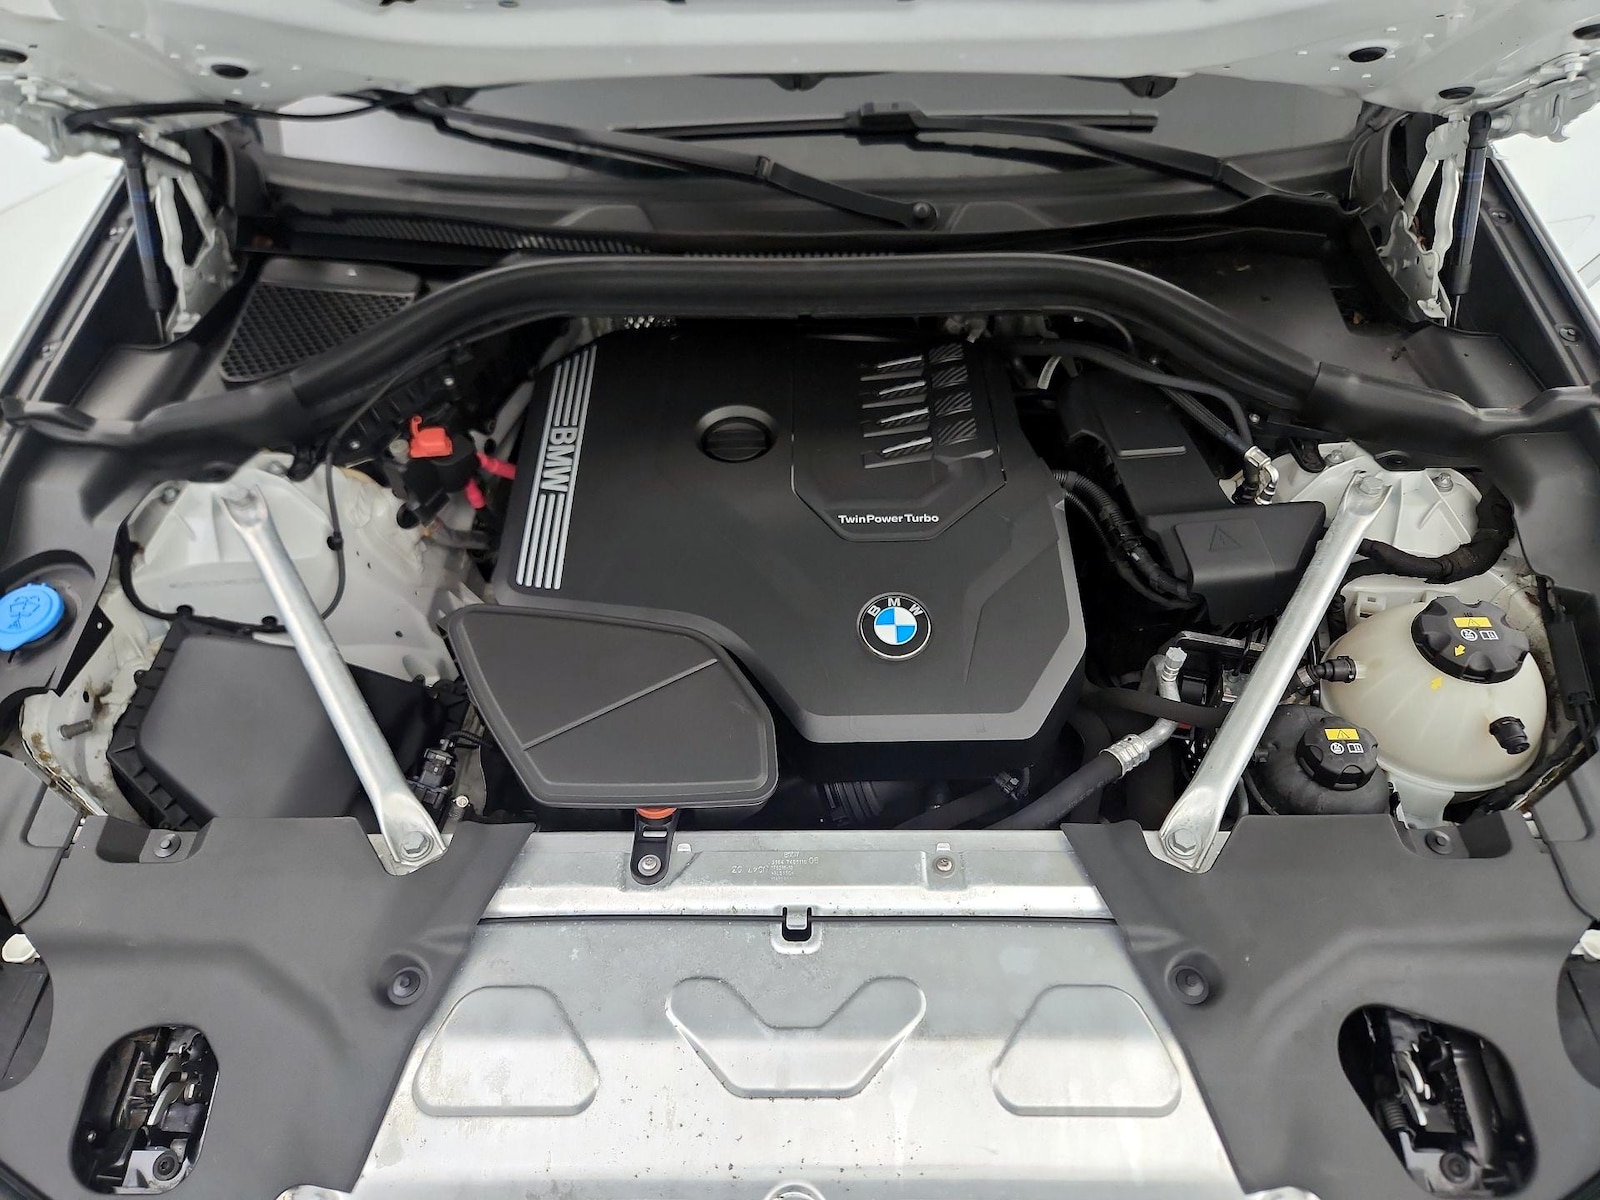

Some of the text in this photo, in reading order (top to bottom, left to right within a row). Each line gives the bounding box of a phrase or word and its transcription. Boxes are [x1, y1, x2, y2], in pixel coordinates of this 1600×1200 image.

[540, 426, 578, 492] BMW
[904, 513, 939, 523] Turbo
[867, 598, 924, 618] BMW
